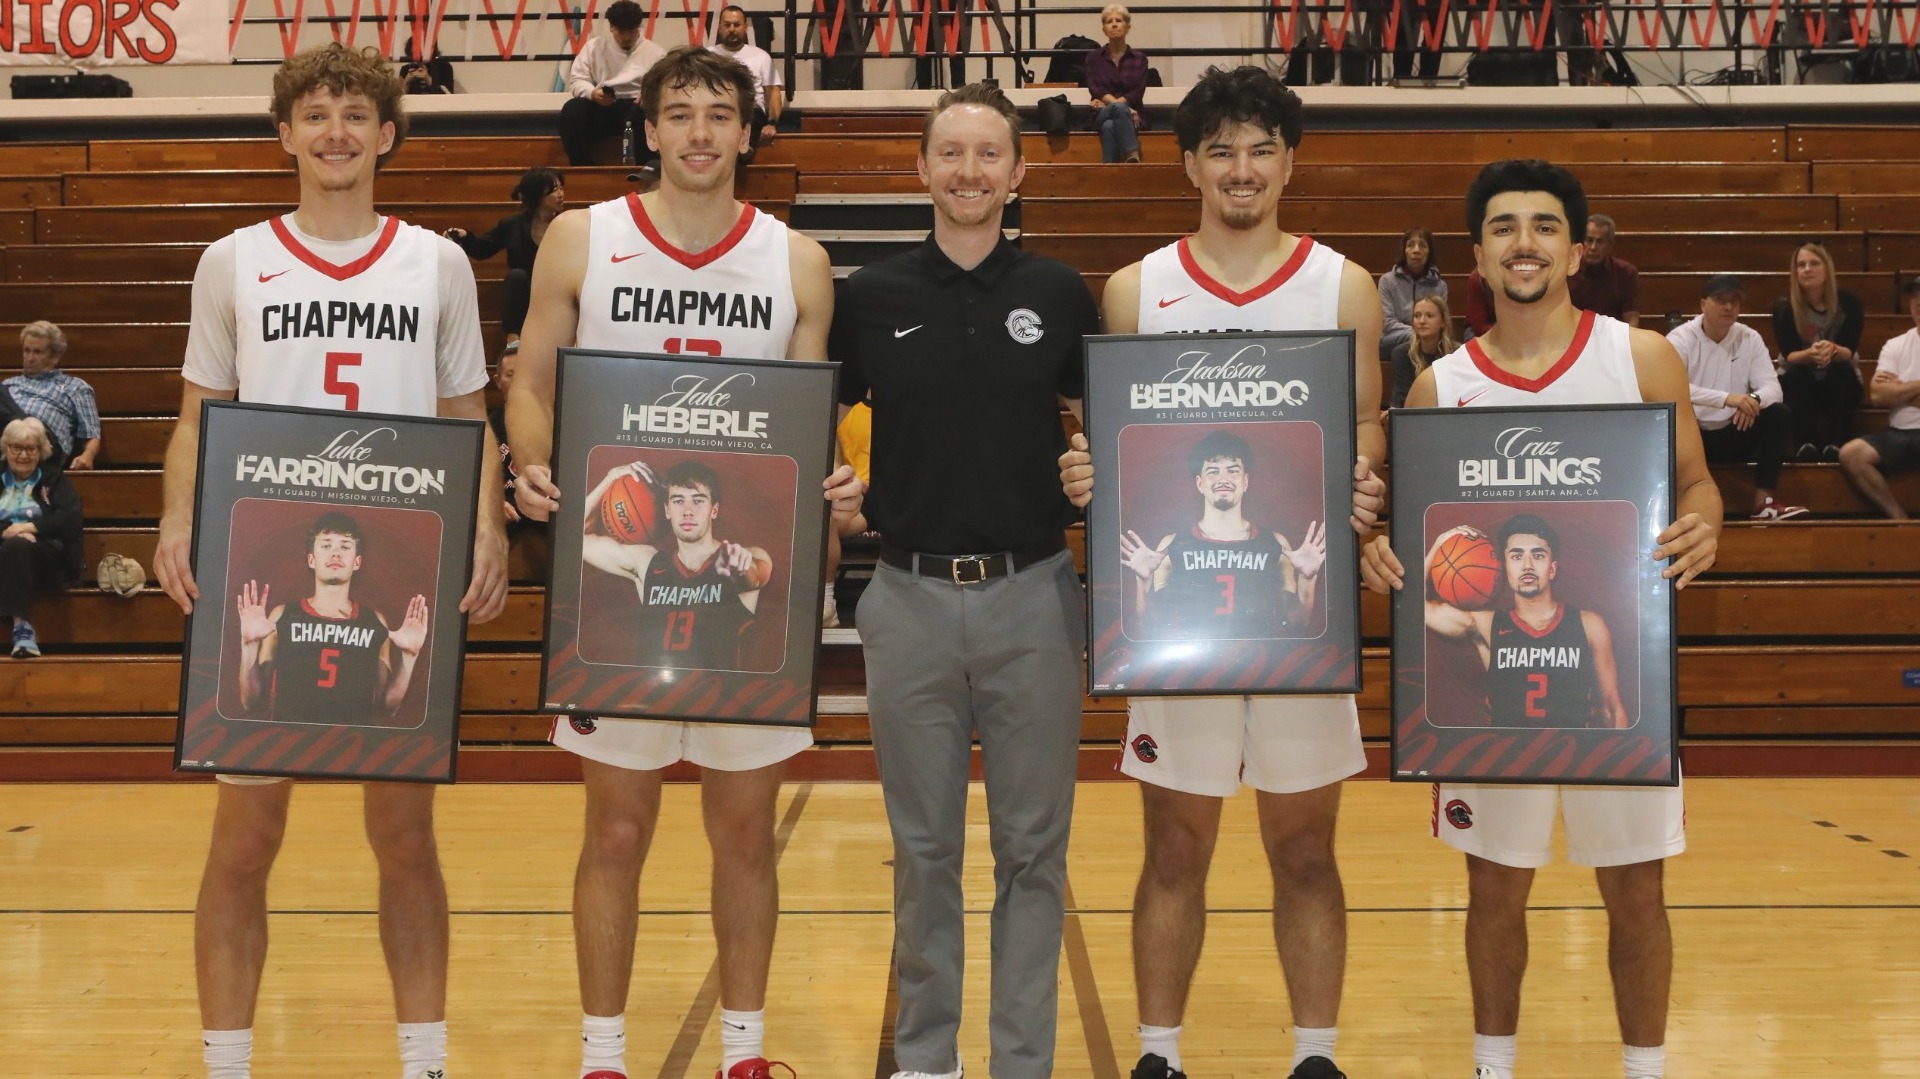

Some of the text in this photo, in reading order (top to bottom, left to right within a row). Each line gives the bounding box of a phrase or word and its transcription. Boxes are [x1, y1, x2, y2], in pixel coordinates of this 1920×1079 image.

[262, 301, 419, 342] CHAPMAN
[611, 286, 772, 330] CHAPMAN
[324, 352, 362, 411] 5
[1161, 344, 1267, 384] Jackson
[654, 372, 755, 408] Jake
[1130, 380, 1310, 410] BERNARDO
[622, 404, 769, 439] HEBERLE
[1217, 410, 1268, 419] TEMECULA,
[306, 427, 397, 463] Luke
[616, 434, 631, 442] #13
[641, 435, 674, 444] GUARD
[684, 438, 724, 447] MISSION
[727, 440, 757, 450] VIEJO,
[760, 442, 773, 450] CA
[1494, 427, 1564, 459] Cruz
[235, 454, 446, 496] FARRINGTON
[1458, 457, 1603, 487] BILLINGS
[263, 487, 275, 495] #5
[284, 488, 317, 498] GUARD
[327, 492, 367, 501] MISSION
[371, 495, 400, 504] VIEJO,
[404, 497, 417, 505] CA
[1461, 490, 1472, 498] #2
[1559, 489, 1583, 497] ANA,
[1586, 488, 1599, 496] CA
[1182, 549, 1269, 571] CHAPMAN
[648, 583, 723, 606] CHAPMAN
[1215, 574, 1235, 615] 3
[291, 622, 375, 649] CHAPMAN
[663, 610, 696, 651] 13
[317, 648, 341, 688] 5
[1497, 647, 1580, 669] CHAPMAN
[1525, 673, 1548, 718] 2
